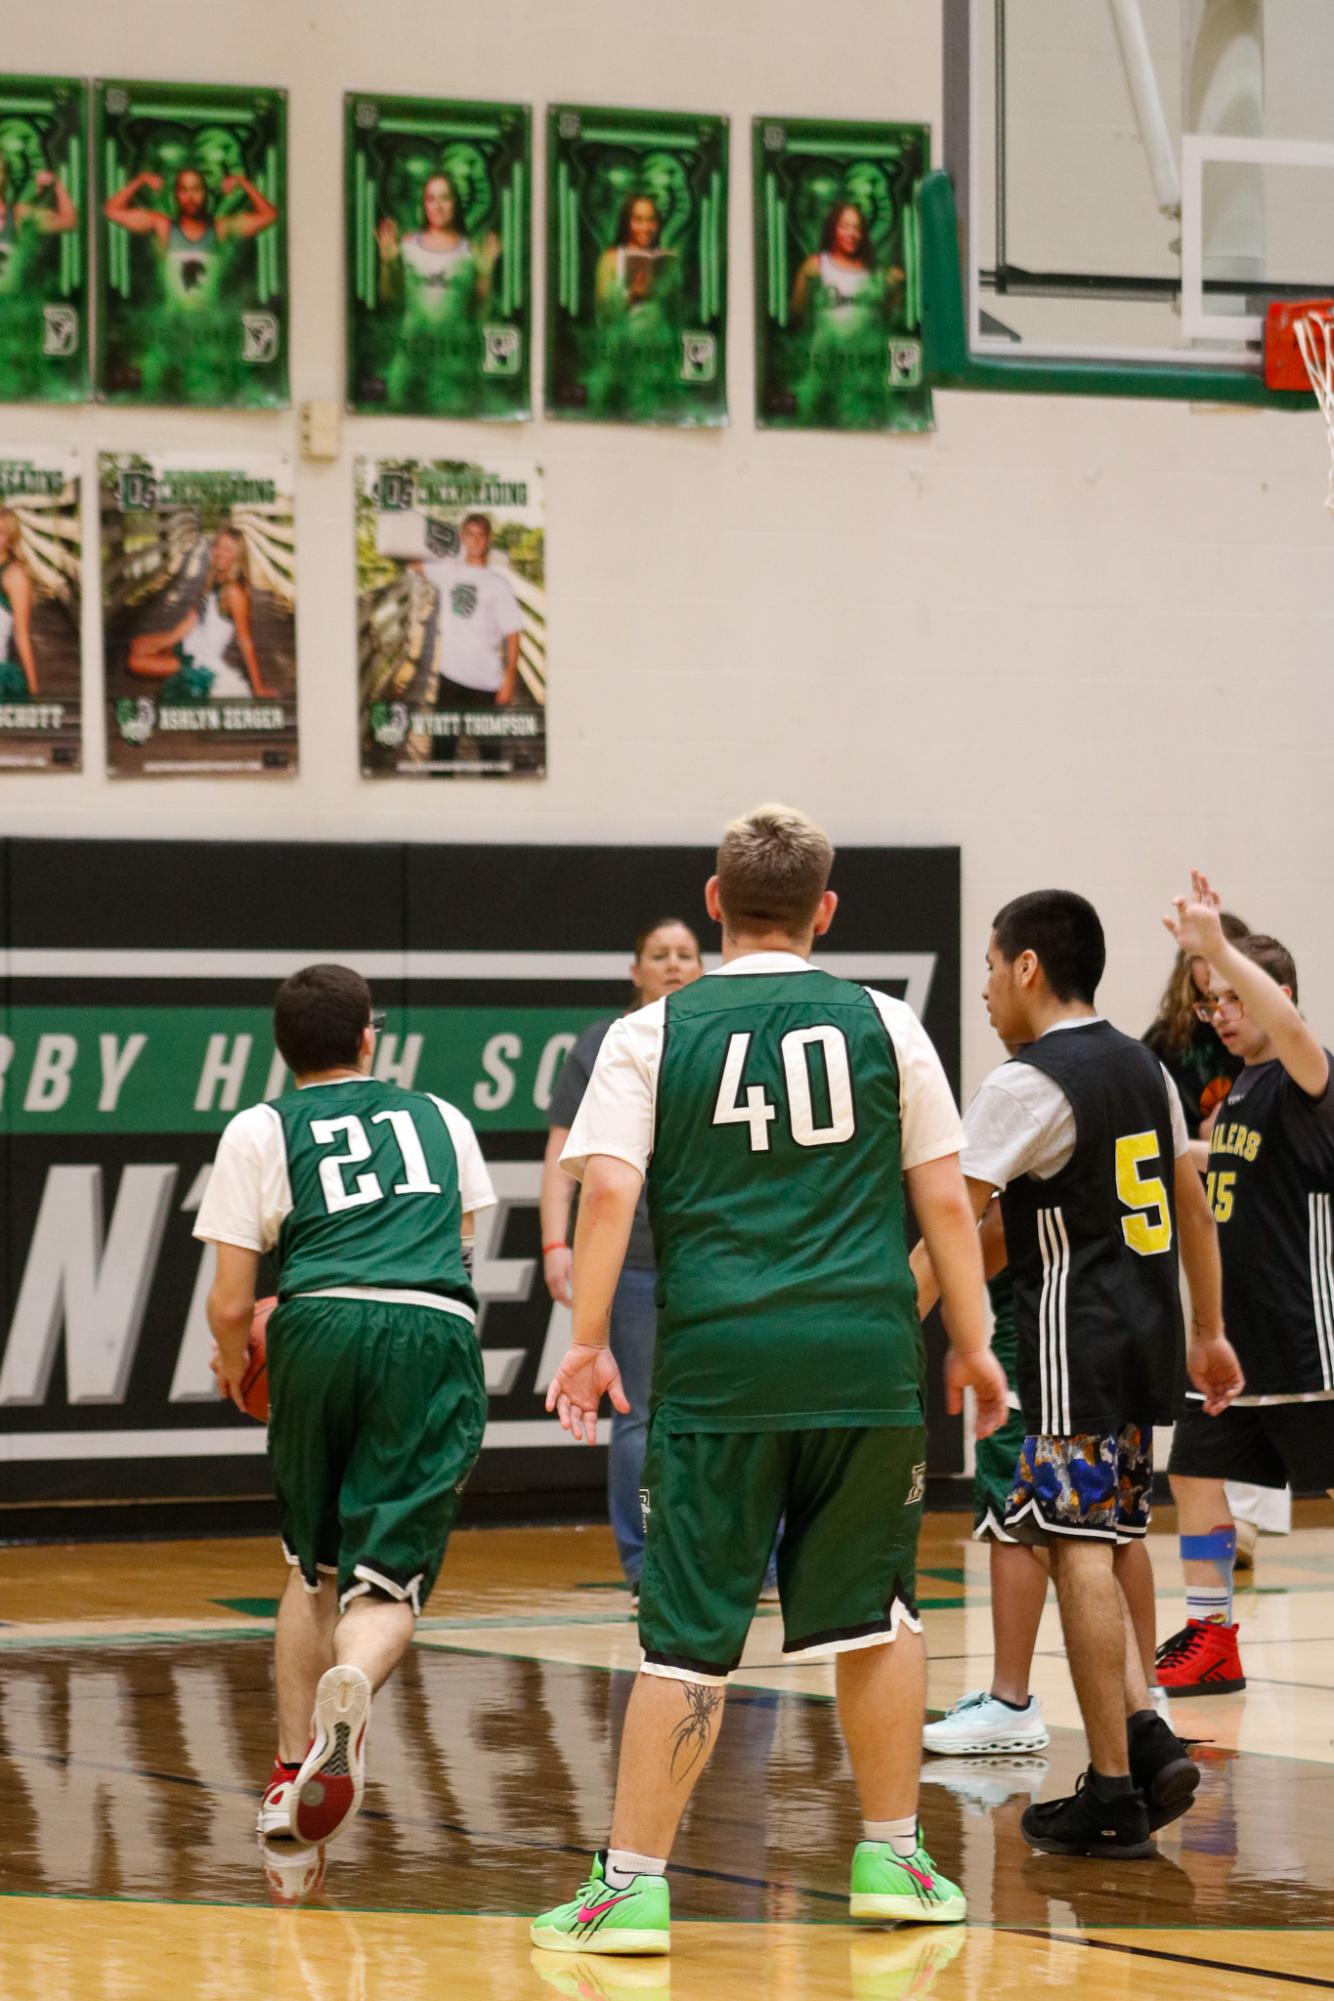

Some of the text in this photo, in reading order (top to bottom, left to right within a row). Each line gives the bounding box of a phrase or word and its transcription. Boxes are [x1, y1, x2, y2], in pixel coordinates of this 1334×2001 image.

[0, 1033, 147, 1111] BY
[712, 1025, 855, 1151] 40
[310, 1110, 441, 1214] 21
[1115, 1129, 1171, 1255] 5
[1206, 1171, 1236, 1223] 15
